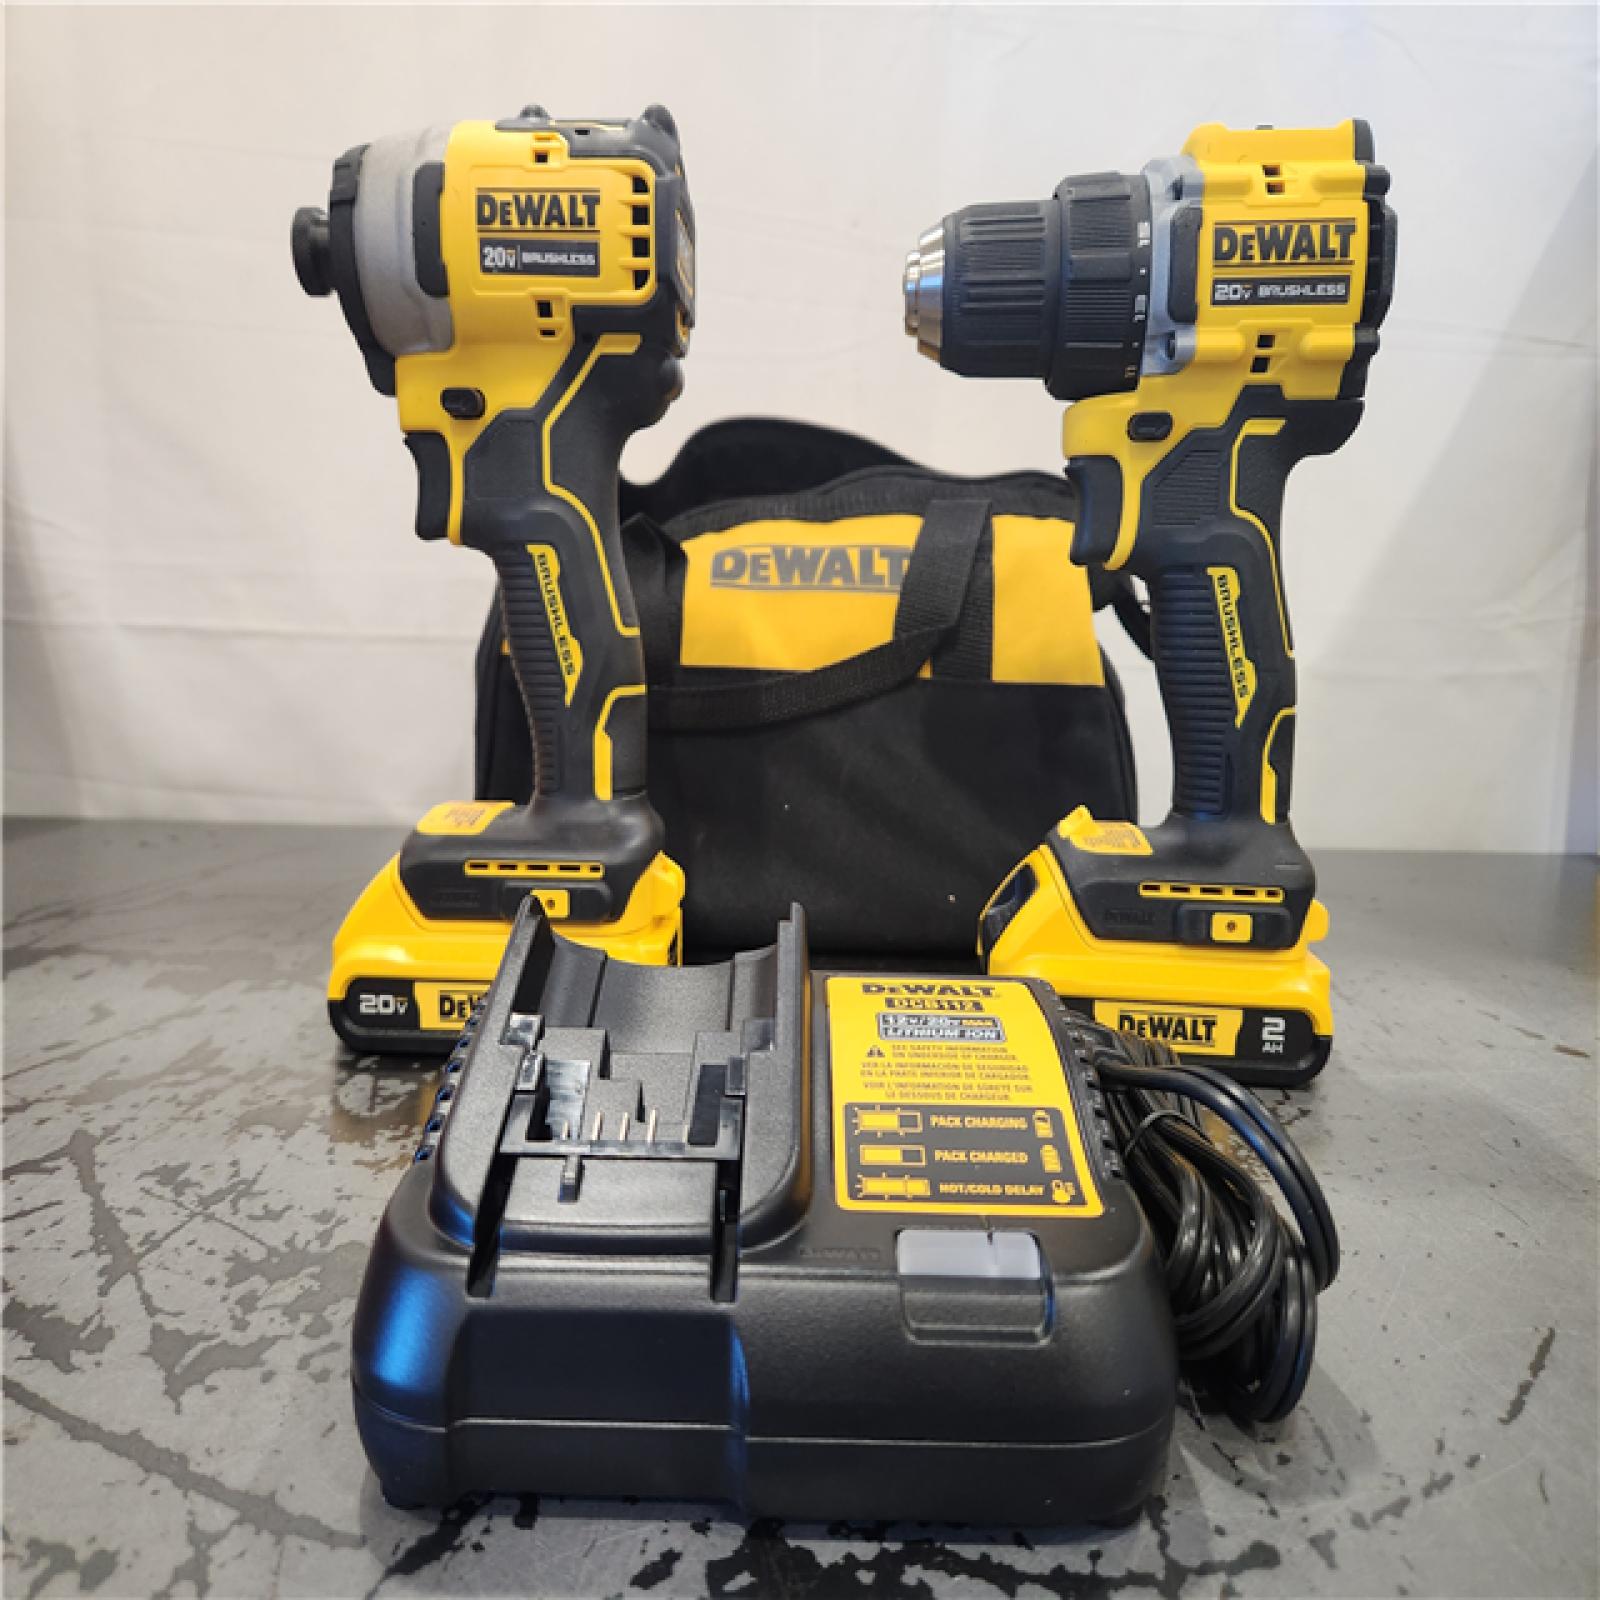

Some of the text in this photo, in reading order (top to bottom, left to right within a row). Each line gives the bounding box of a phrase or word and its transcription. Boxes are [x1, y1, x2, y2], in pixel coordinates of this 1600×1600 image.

[1258, 283, 1346, 299] BRUSHLESS
[537, 553, 576, 676] BRUSHLESS
[1217, 574, 1249, 698] BRUSHLESS
[1261, 1016, 1286, 1041] 2
[930, 1114, 1028, 1130] PACK CHARGING
[934, 1149, 1029, 1164] PACK CHARGED
[939, 1183, 1045, 1196] HOT/COLD DELAY
